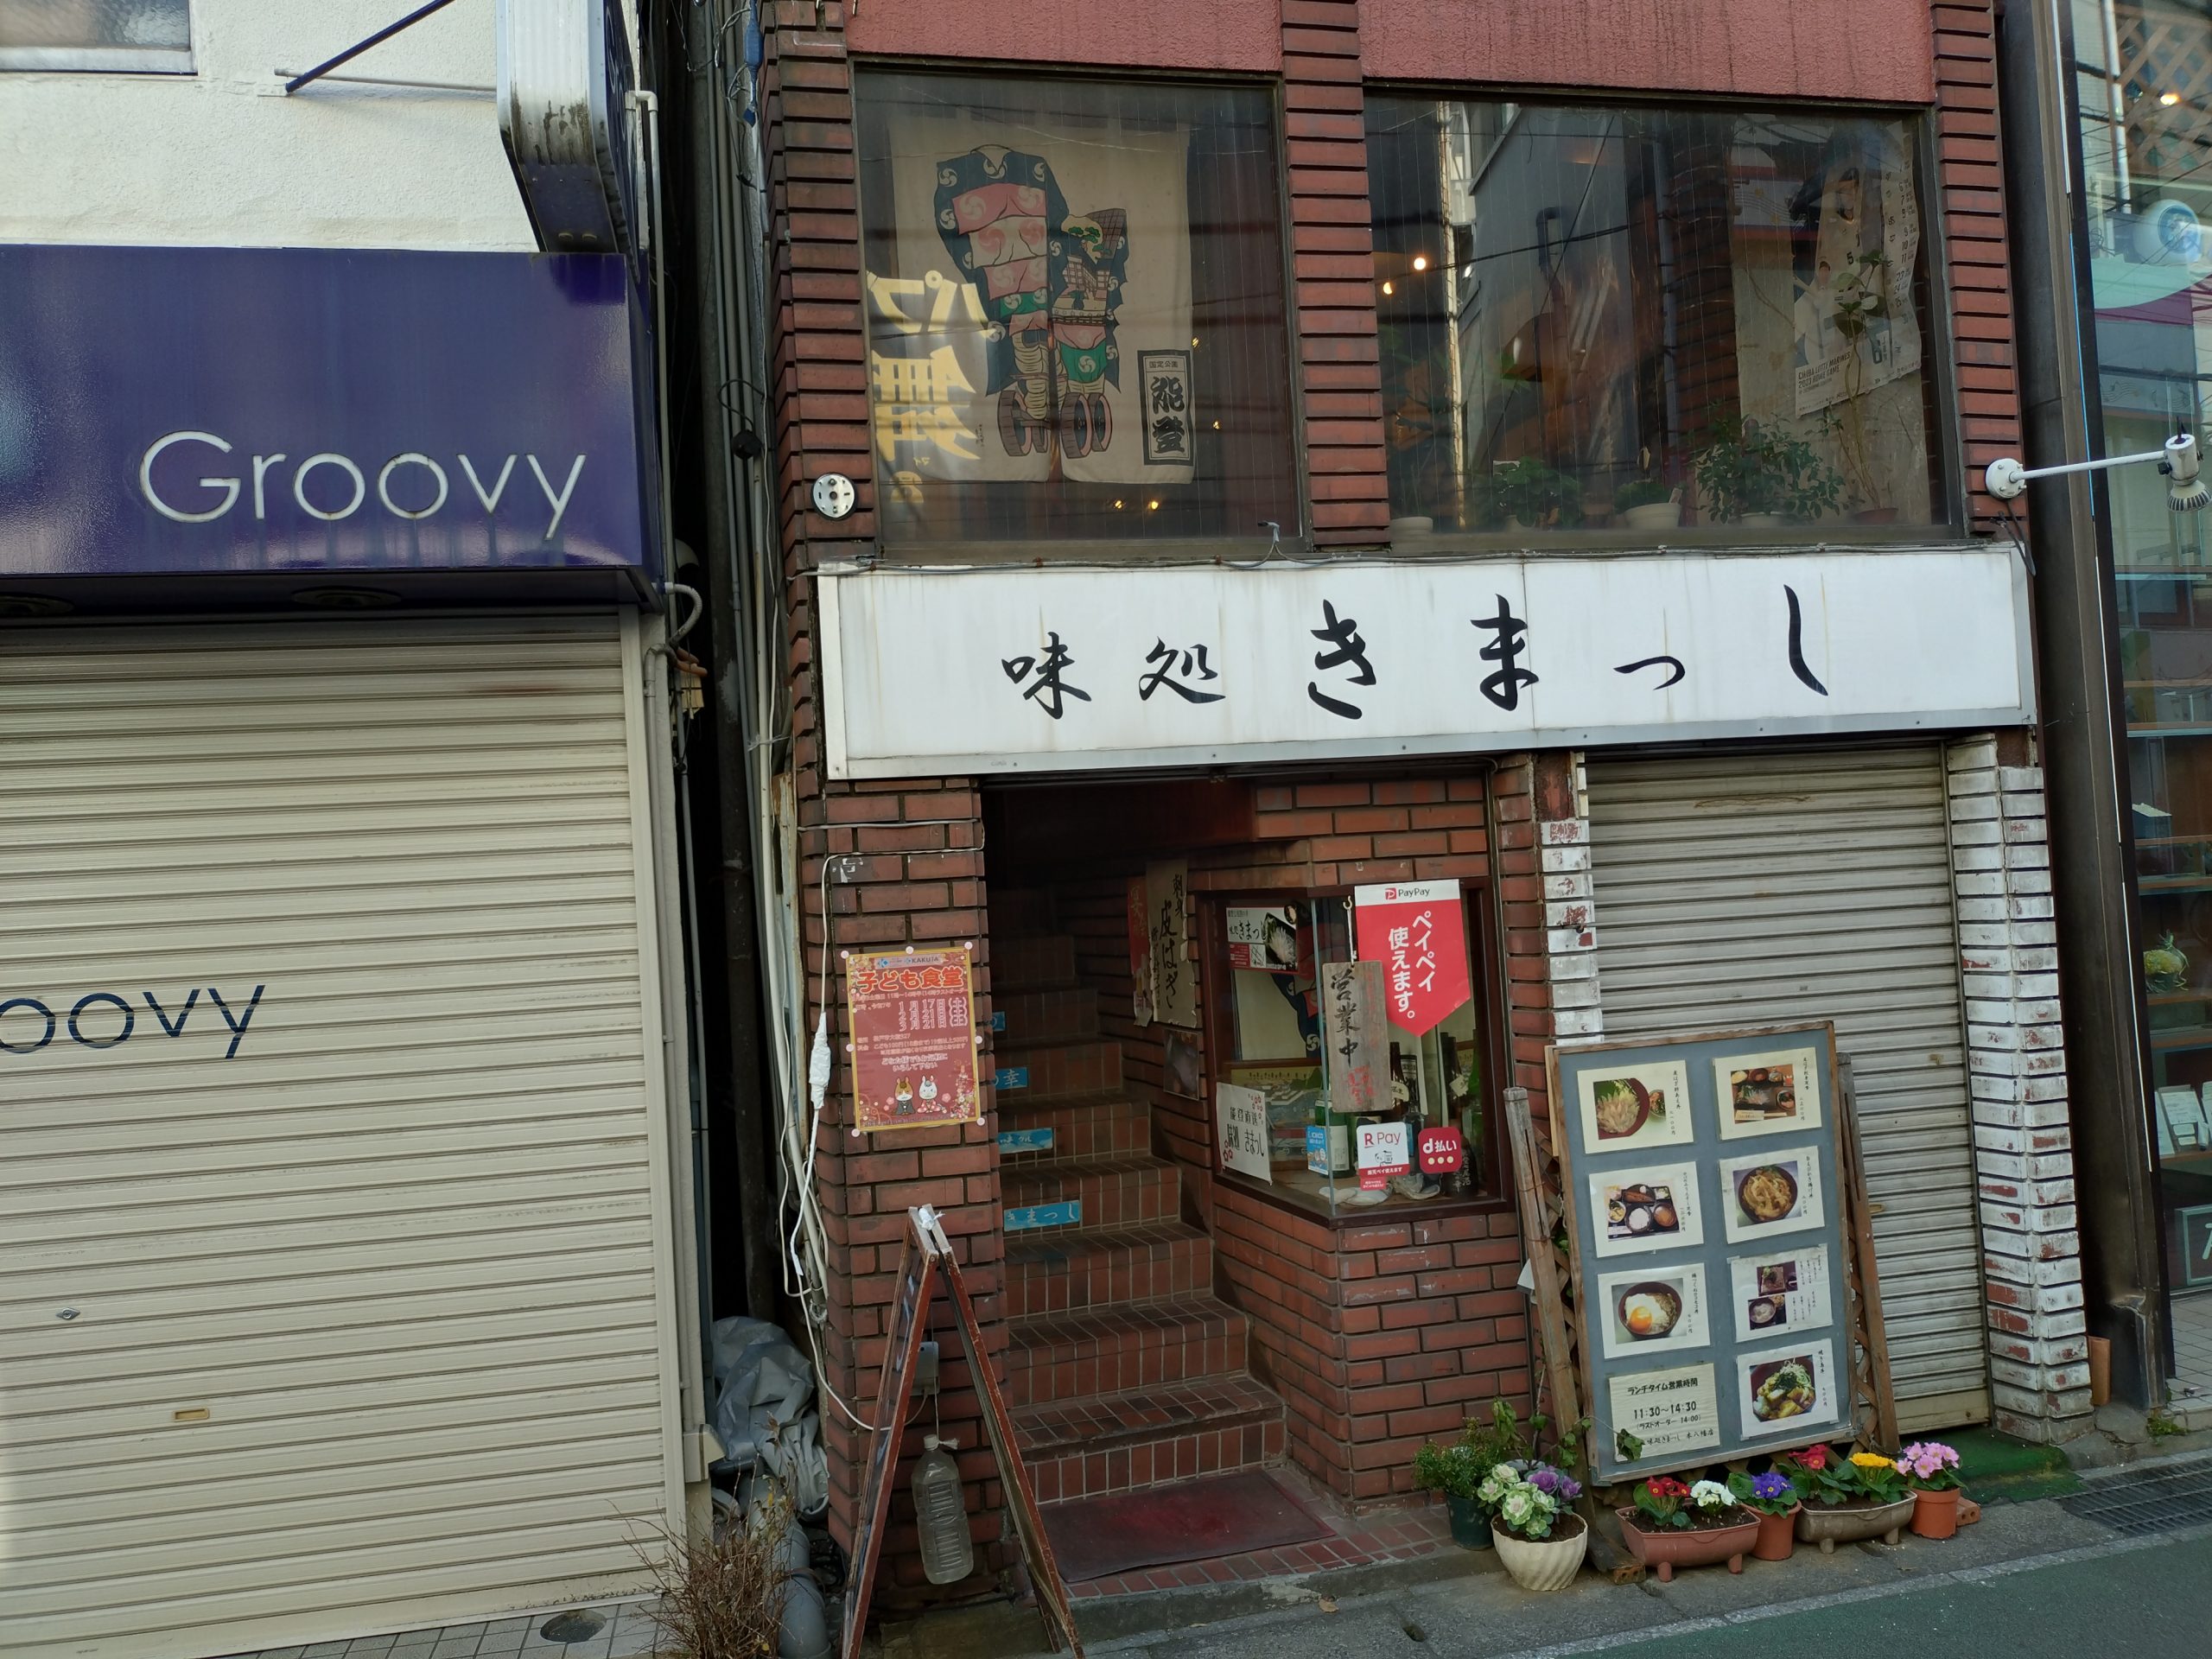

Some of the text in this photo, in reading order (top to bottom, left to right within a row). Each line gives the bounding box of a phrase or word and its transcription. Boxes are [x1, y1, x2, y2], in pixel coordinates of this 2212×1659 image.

[1148, 360, 1179, 369] 国定公園
[1149, 375, 1186, 454] 能登
[139, 429, 588, 542] Groovy
[1398, 887, 1431, 899] PayPay
[1412, 910, 1436, 994] ペイペイ
[856, 965, 965, 995] 子ども食堂
[1388, 926, 1416, 1020] 使えます。
[1330, 967, 1361, 1067] 営業中
[1376, 1132, 1402, 1146] Pay
[1422, 1137, 1458, 1154] d払い
[1006, 1202, 1076, 1224] きまっし
[1627, 1377, 1699, 1395] ランチタイム営業時間
